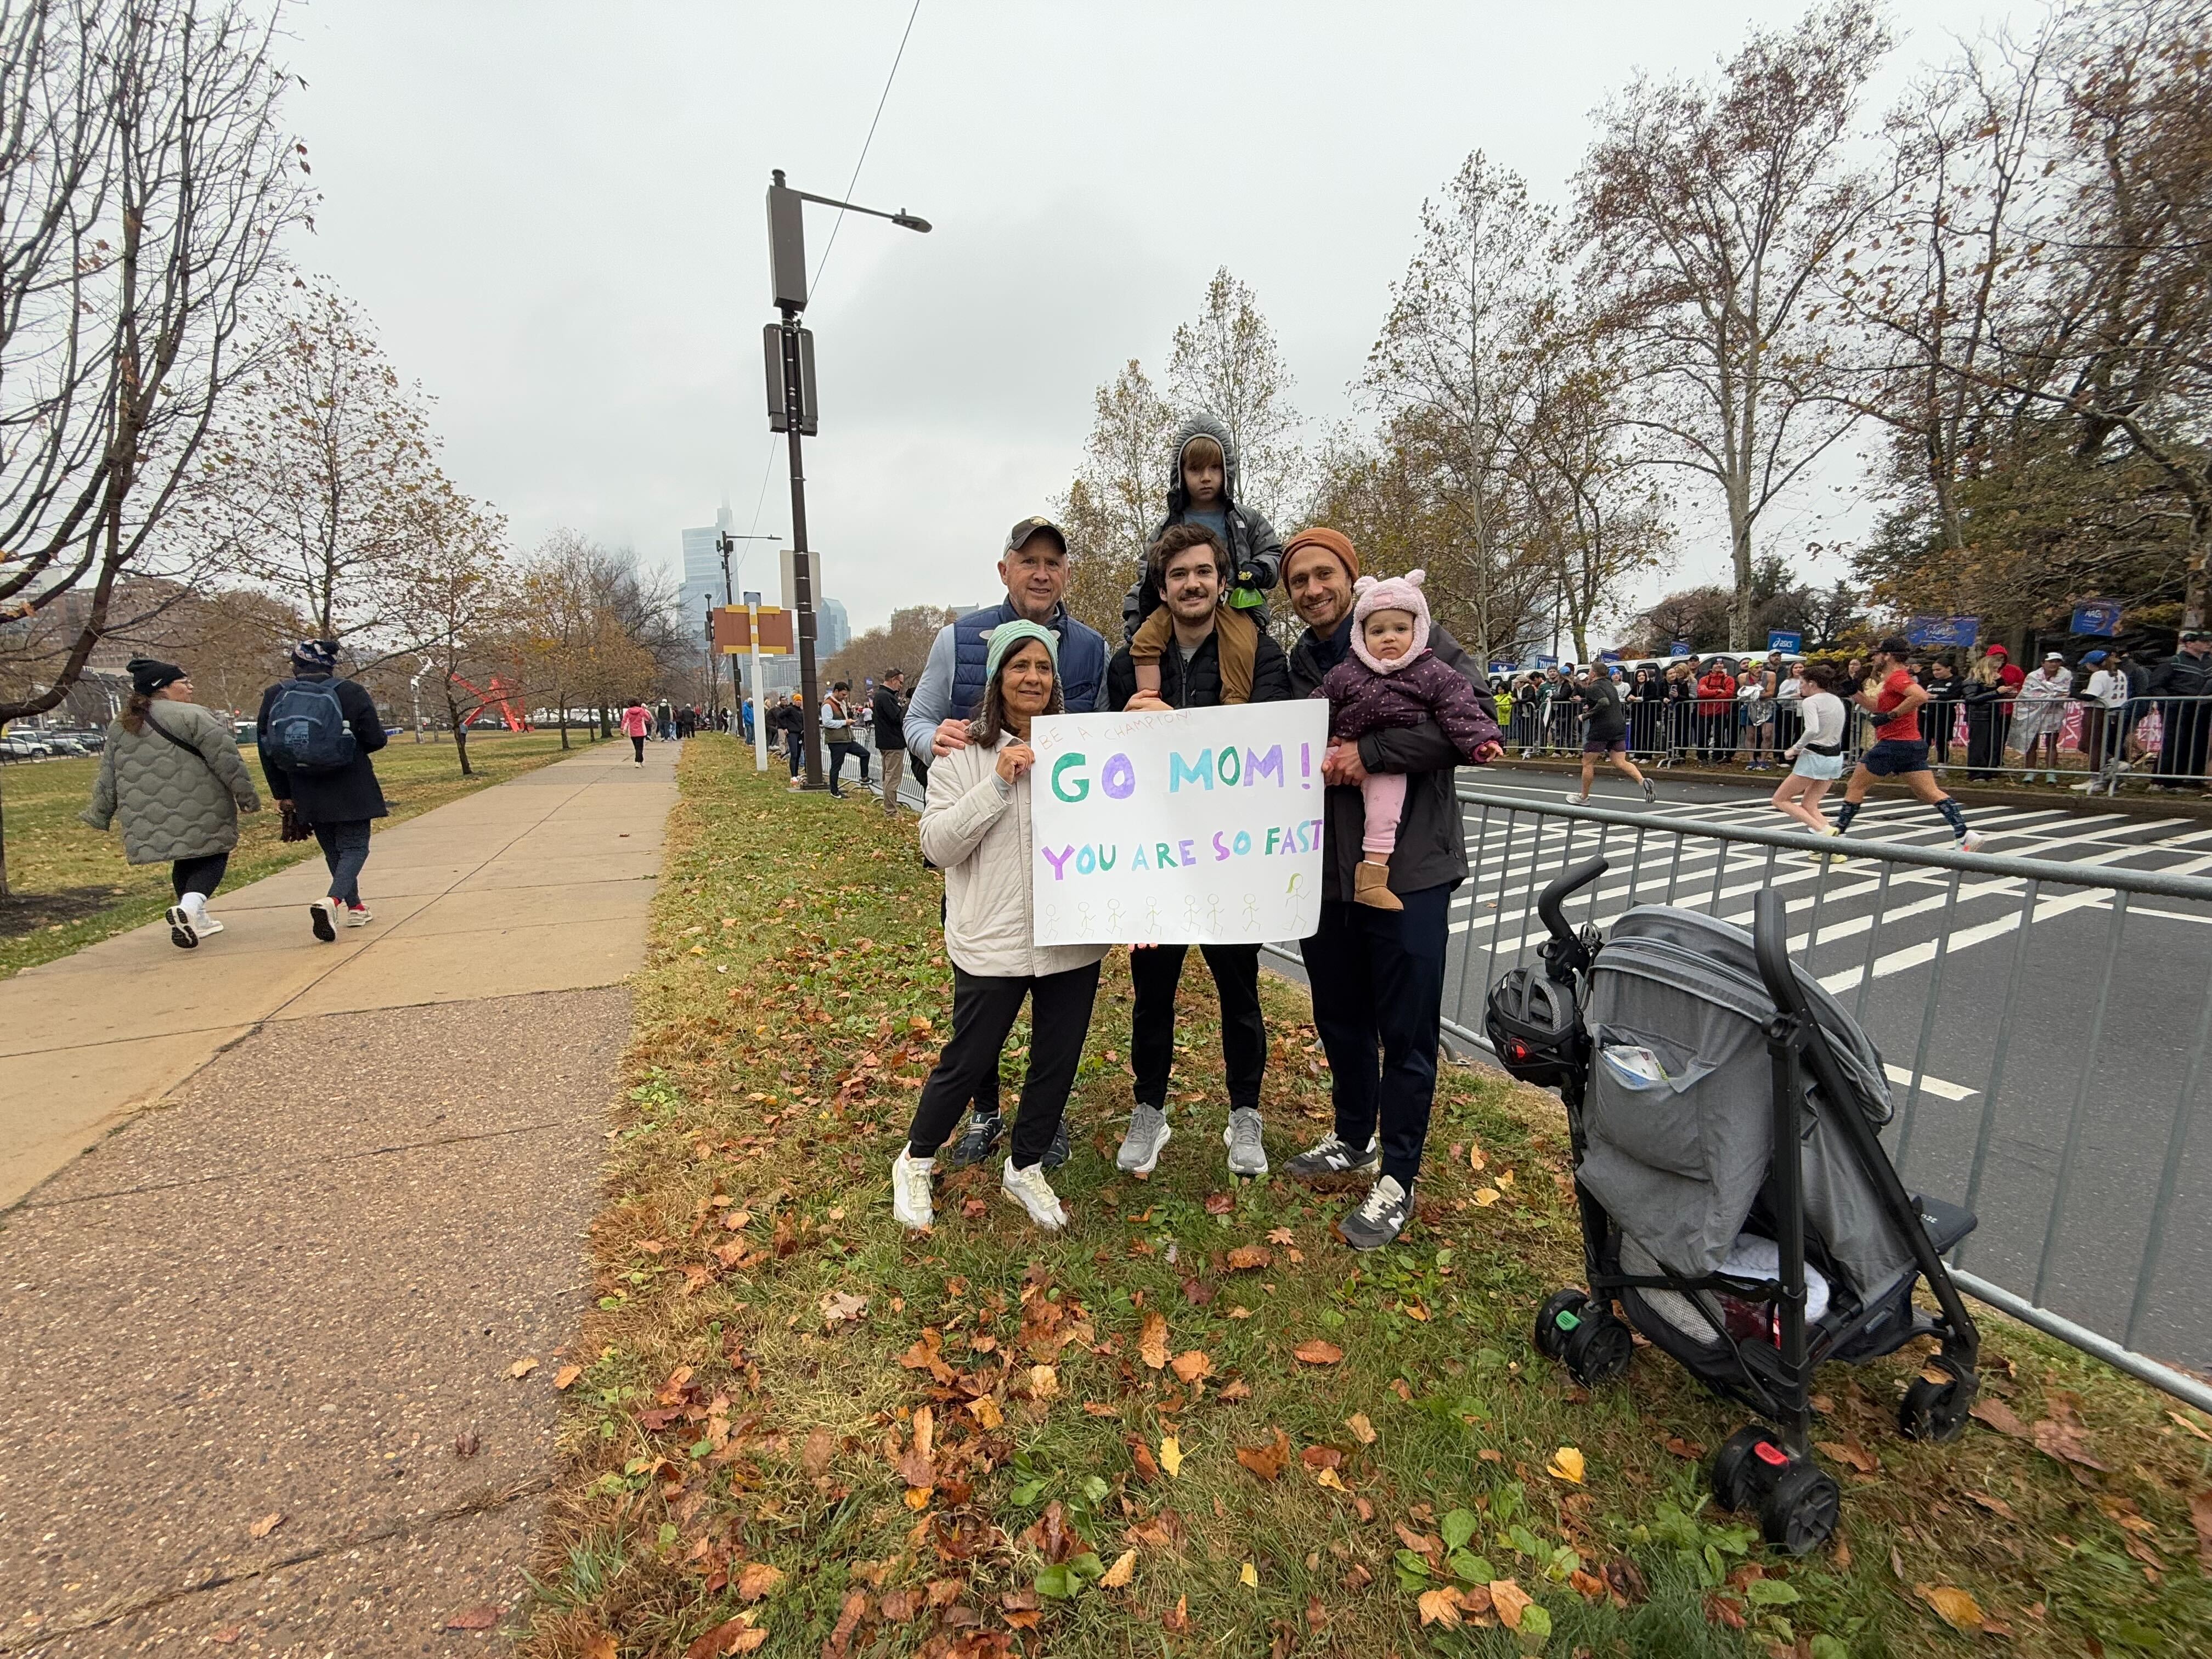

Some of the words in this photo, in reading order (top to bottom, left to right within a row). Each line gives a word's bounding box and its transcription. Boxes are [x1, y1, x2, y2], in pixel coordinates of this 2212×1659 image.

[1038, 727, 1063, 750] BE
[1077, 726, 1093, 741] A
[1051, 752, 1136, 803] GO
[1041, 843, 1116, 881] YOU
[1131, 839, 1197, 871] ARE
[1212, 830, 1251, 861] SO
[1265, 819, 1323, 856] FAST
